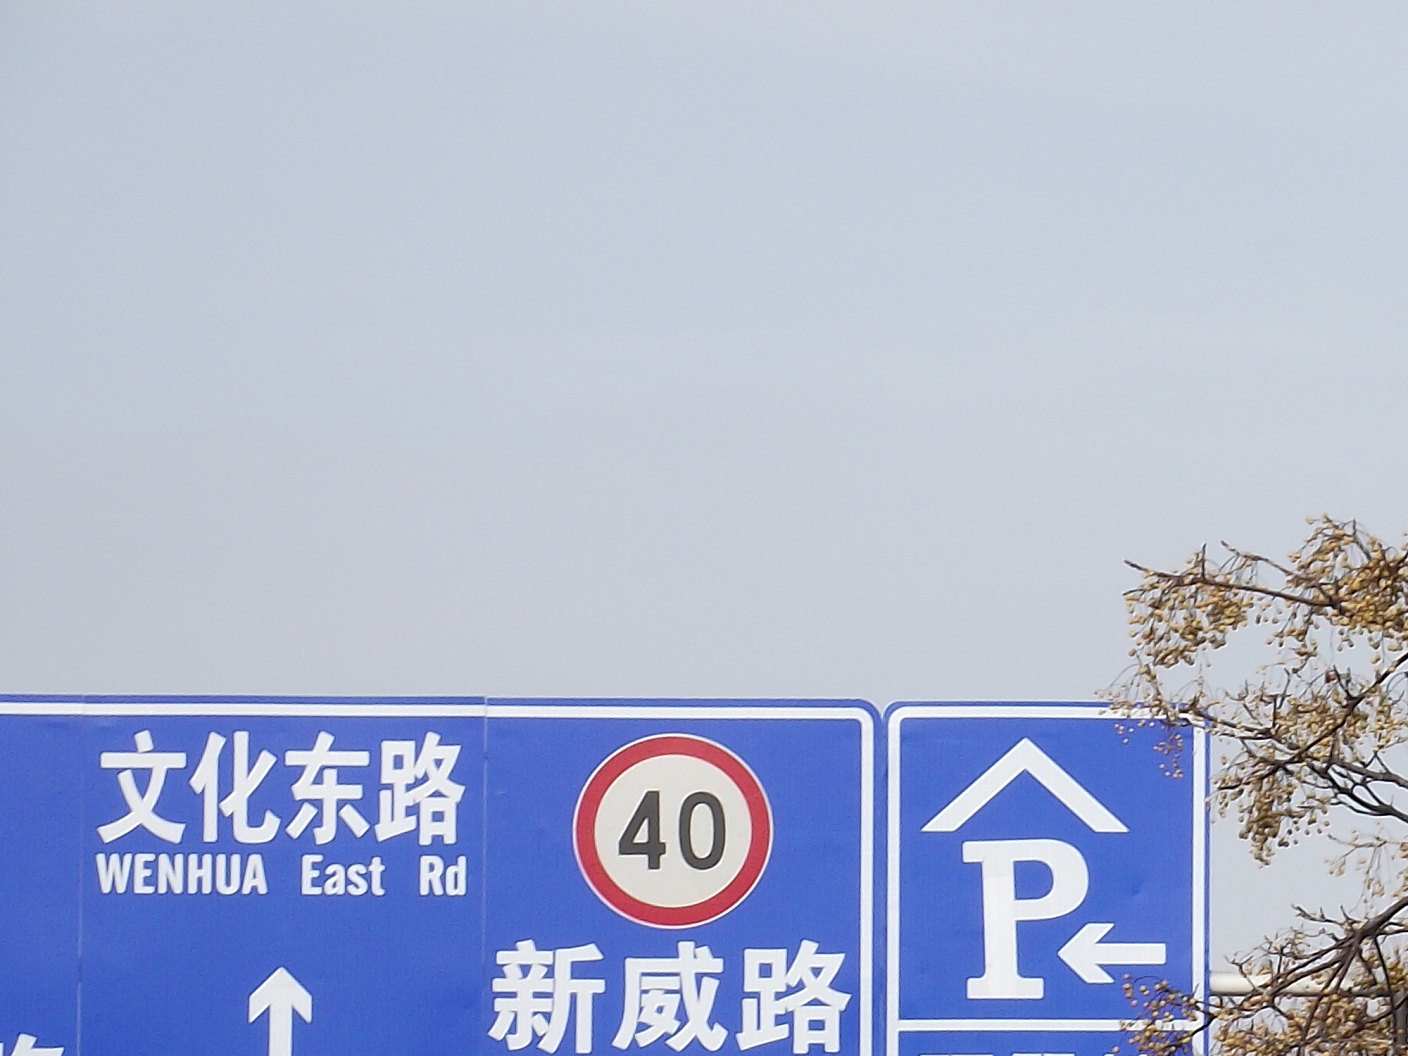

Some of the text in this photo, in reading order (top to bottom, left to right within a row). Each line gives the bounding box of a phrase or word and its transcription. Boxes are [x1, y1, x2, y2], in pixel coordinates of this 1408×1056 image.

[97, 730, 466, 846] 文化东路
[618, 790, 726, 871] 40
[95, 853, 467, 896] WENHUA East Rd
[961, 838, 1090, 1000] P
[488, 939, 852, 1055] 新威路
